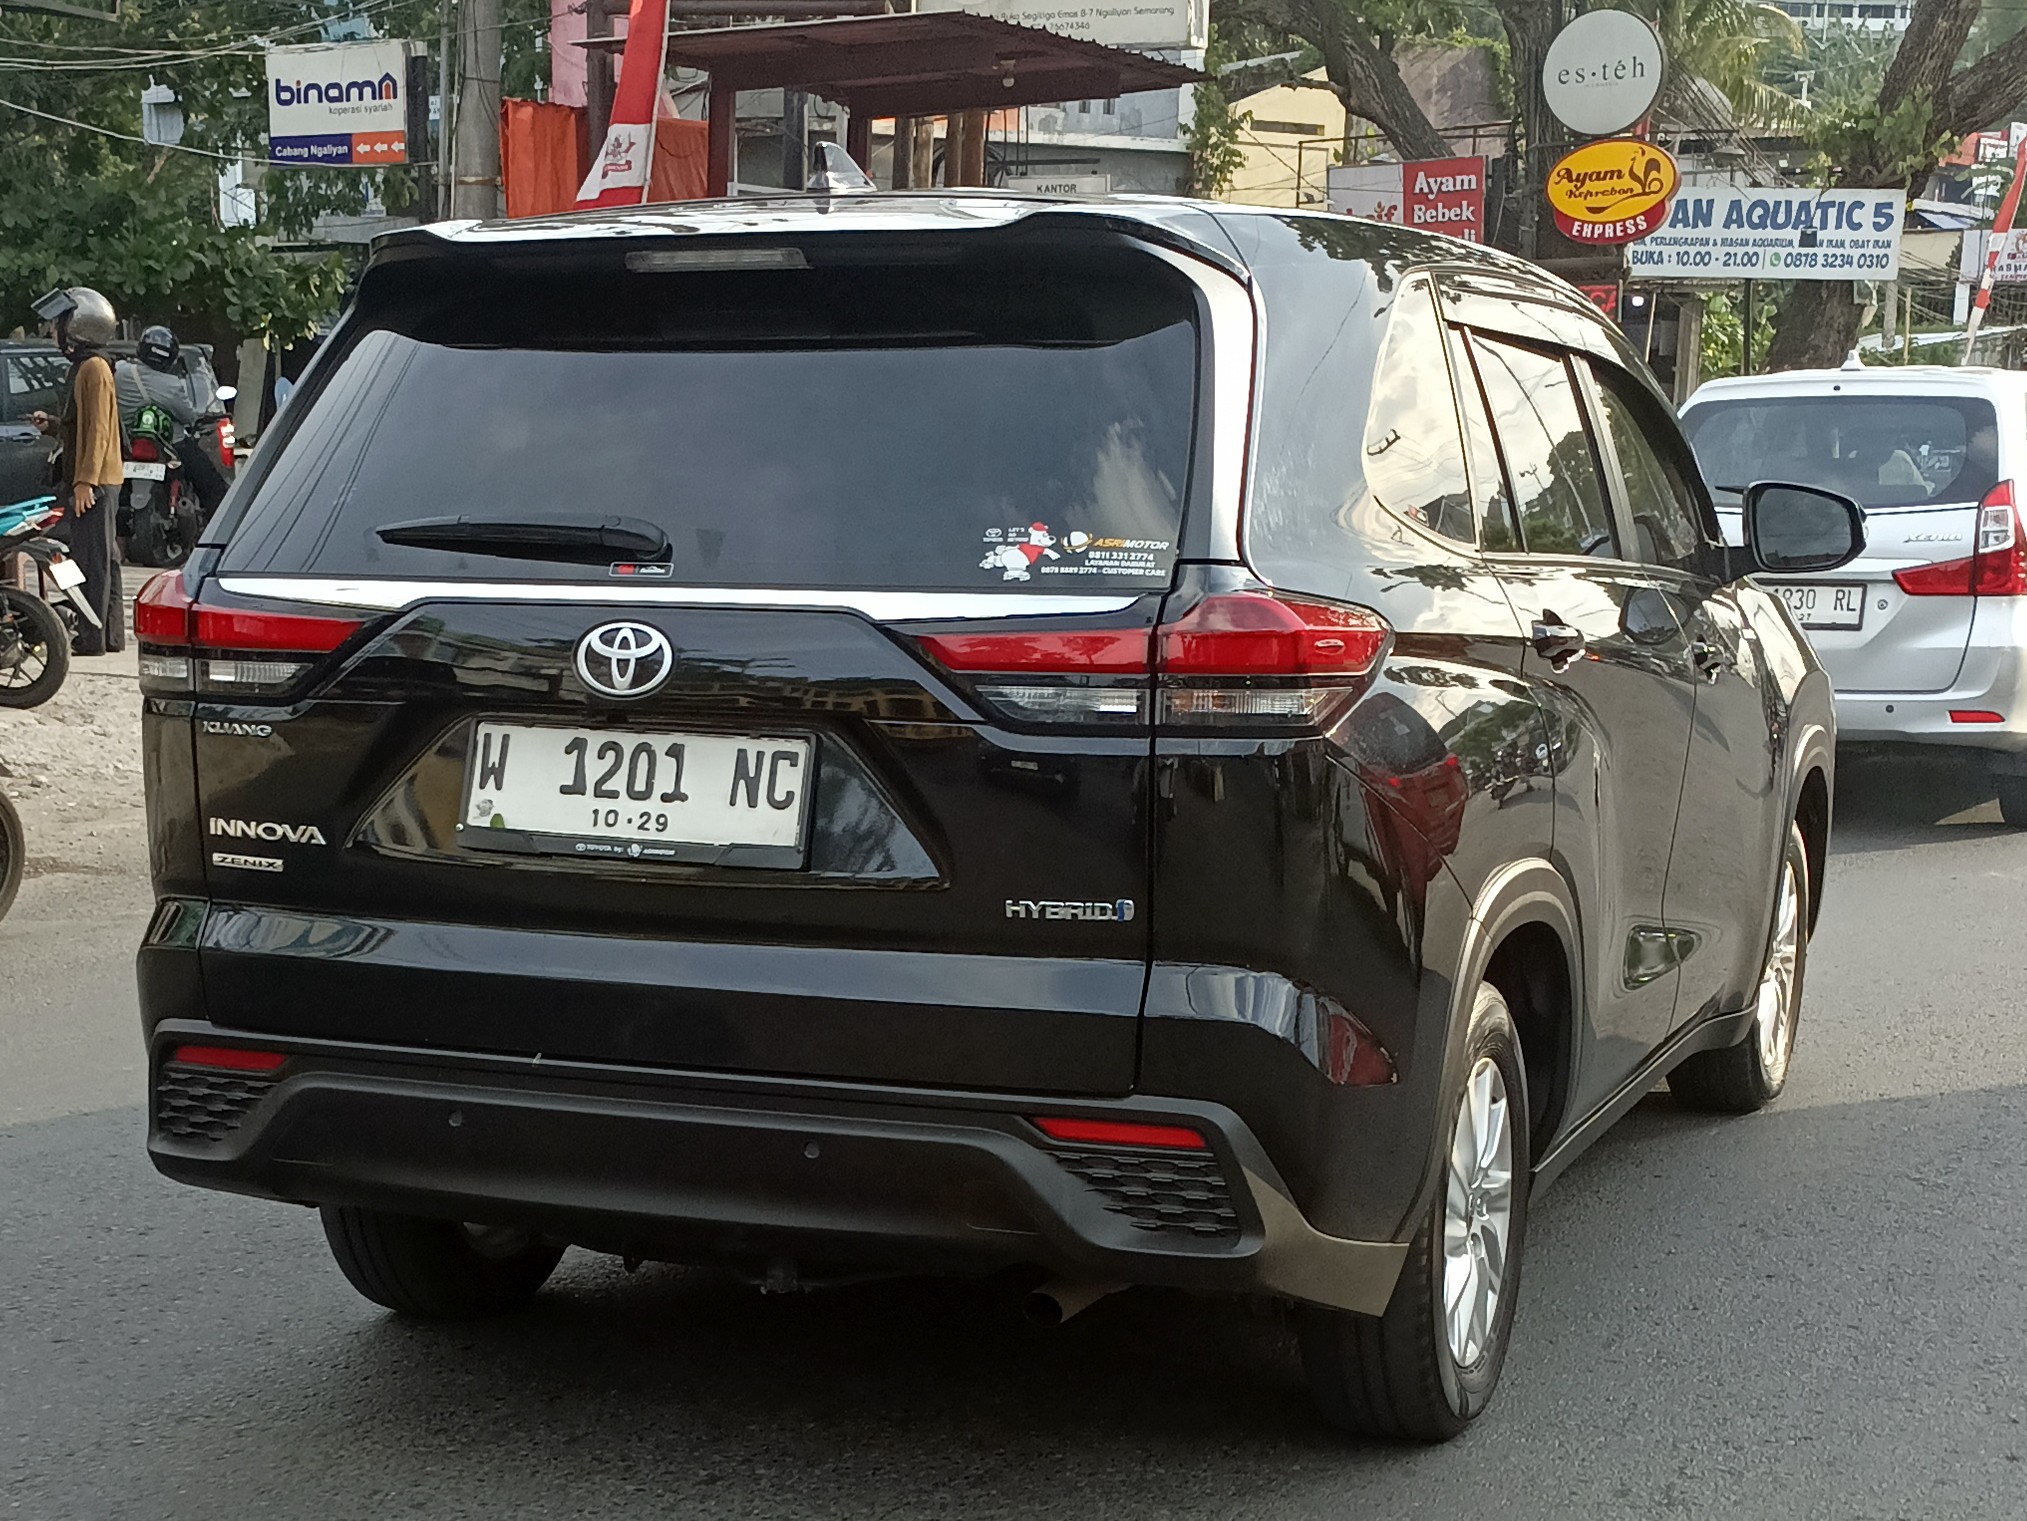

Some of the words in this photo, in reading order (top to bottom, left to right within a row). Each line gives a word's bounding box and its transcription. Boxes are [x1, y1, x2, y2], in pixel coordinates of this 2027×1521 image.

[1134, 6, 1174, 16] Semarang
[328, 105, 362, 116] koperasi
[363, 103, 393, 114] syariah
[275, 146, 309, 157] Cabang
[310, 144, 348, 157] Ngaliyan
[1413, 171, 1477, 200] Ayam
[1554, 167, 1625, 191] Ayam
[1036, 184, 1077, 194] KANTOR
[1413, 201, 1475, 224] Bebek
[1722, 198, 1865, 231] AQUATIC
[1872, 202, 1894, 232] 5
[1571, 215, 1647, 239] EXPRESS
[1650, 236, 1711, 247] PERLENGKAPAN
[1720, 237, 1751, 248] HIASAN
[1849, 239, 1871, 249] OBAT
[1872, 240, 1892, 249] IKAN
[1631, 250, 1664, 265] BUKA
[1676, 250, 1712, 267] 10.00
[1722, 251, 1760, 268] 21.00
[1784, 252, 1818, 268] 0878
[1821, 252, 1854, 268] 3234
[1857, 253, 1890, 269] 0310
[1102, 567, 1144, 576] CUSTOMER
[1145, 568, 1166, 577] CARE
[1833, 589, 1857, 611] RL
[479, 733, 510, 791] W
[559, 737, 689, 802] 1201
[729, 748, 799, 810] NC
[209, 817, 327, 845] INNOVA
[214, 855, 281, 870] ZENIX
[1005, 899, 1113, 920] HYBRID
